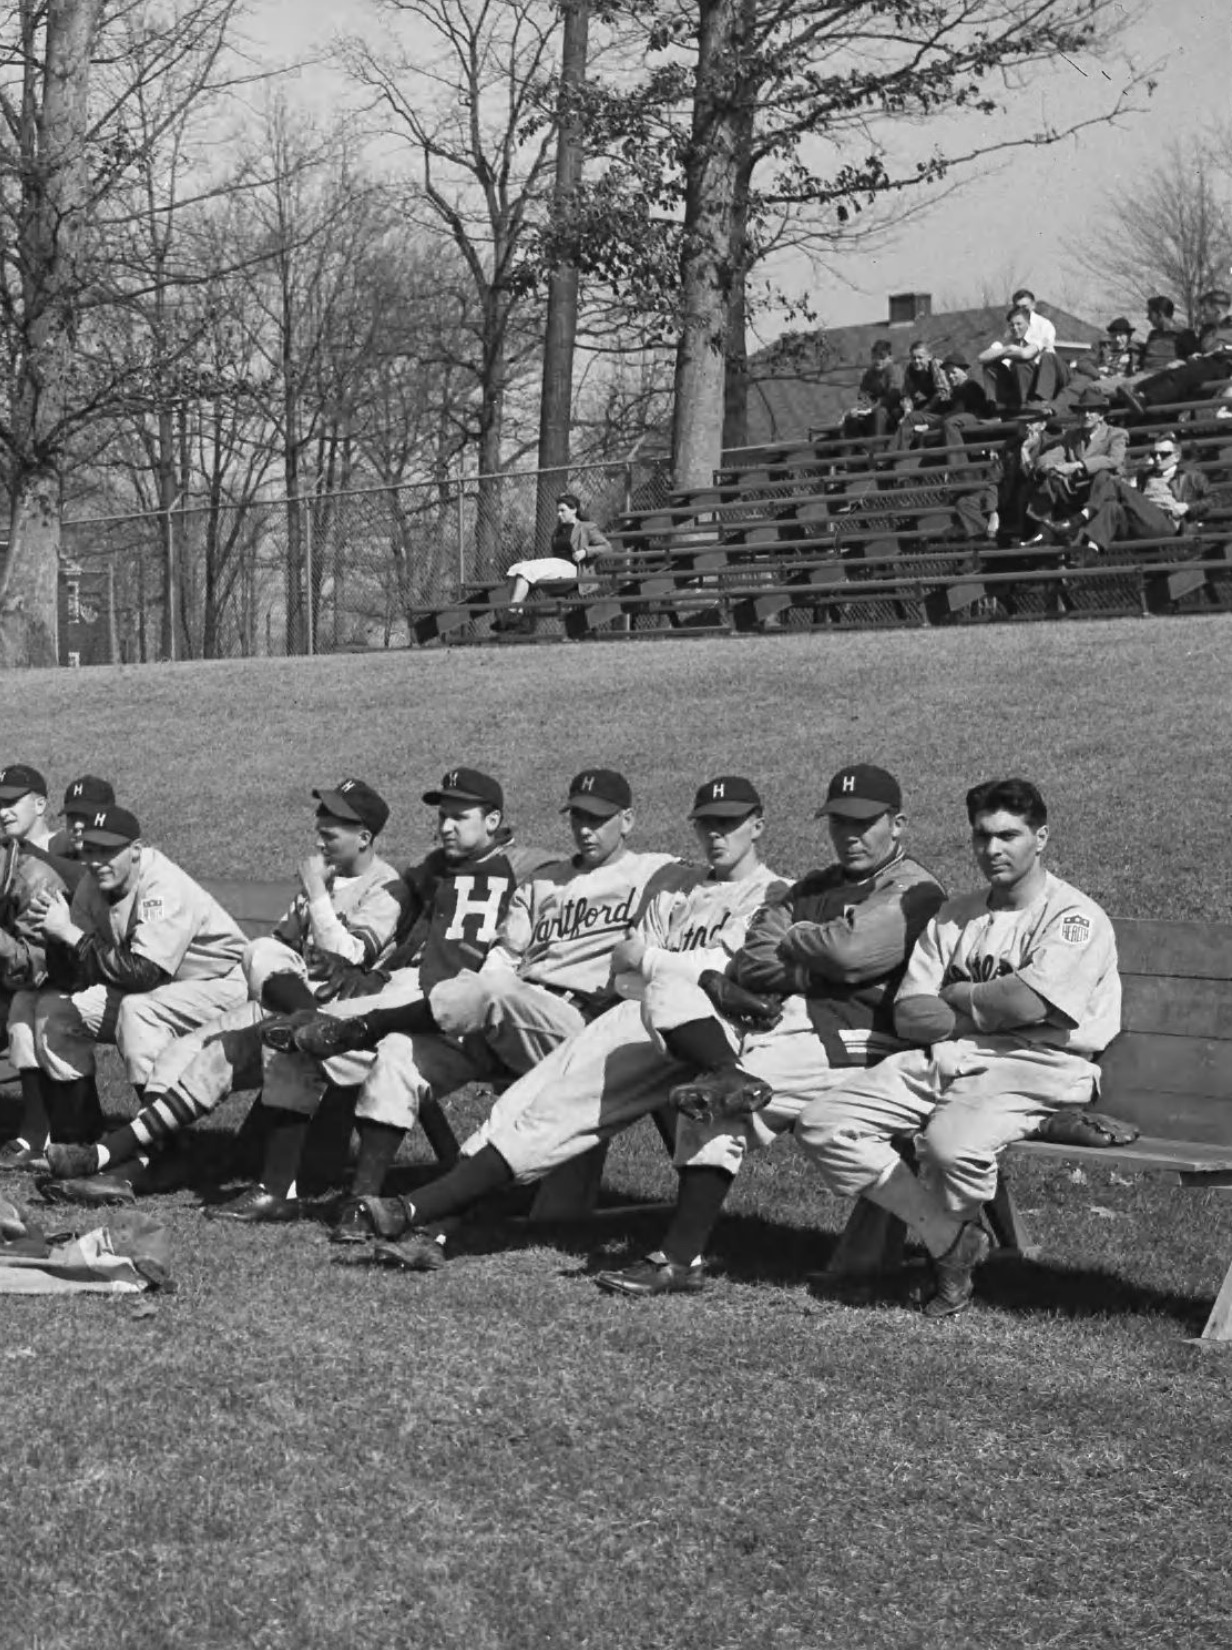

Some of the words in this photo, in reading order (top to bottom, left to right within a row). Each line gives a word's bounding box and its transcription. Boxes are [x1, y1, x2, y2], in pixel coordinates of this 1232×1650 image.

[449, 772, 458, 786] H
[582, 777, 595, 791] H
[843, 776, 855, 792] H
[74, 784, 83, 796] H
[341, 780, 356, 793] H
[713, 784, 725, 798] H
[95, 813, 107, 827] H
[445, 876, 508, 942] H
